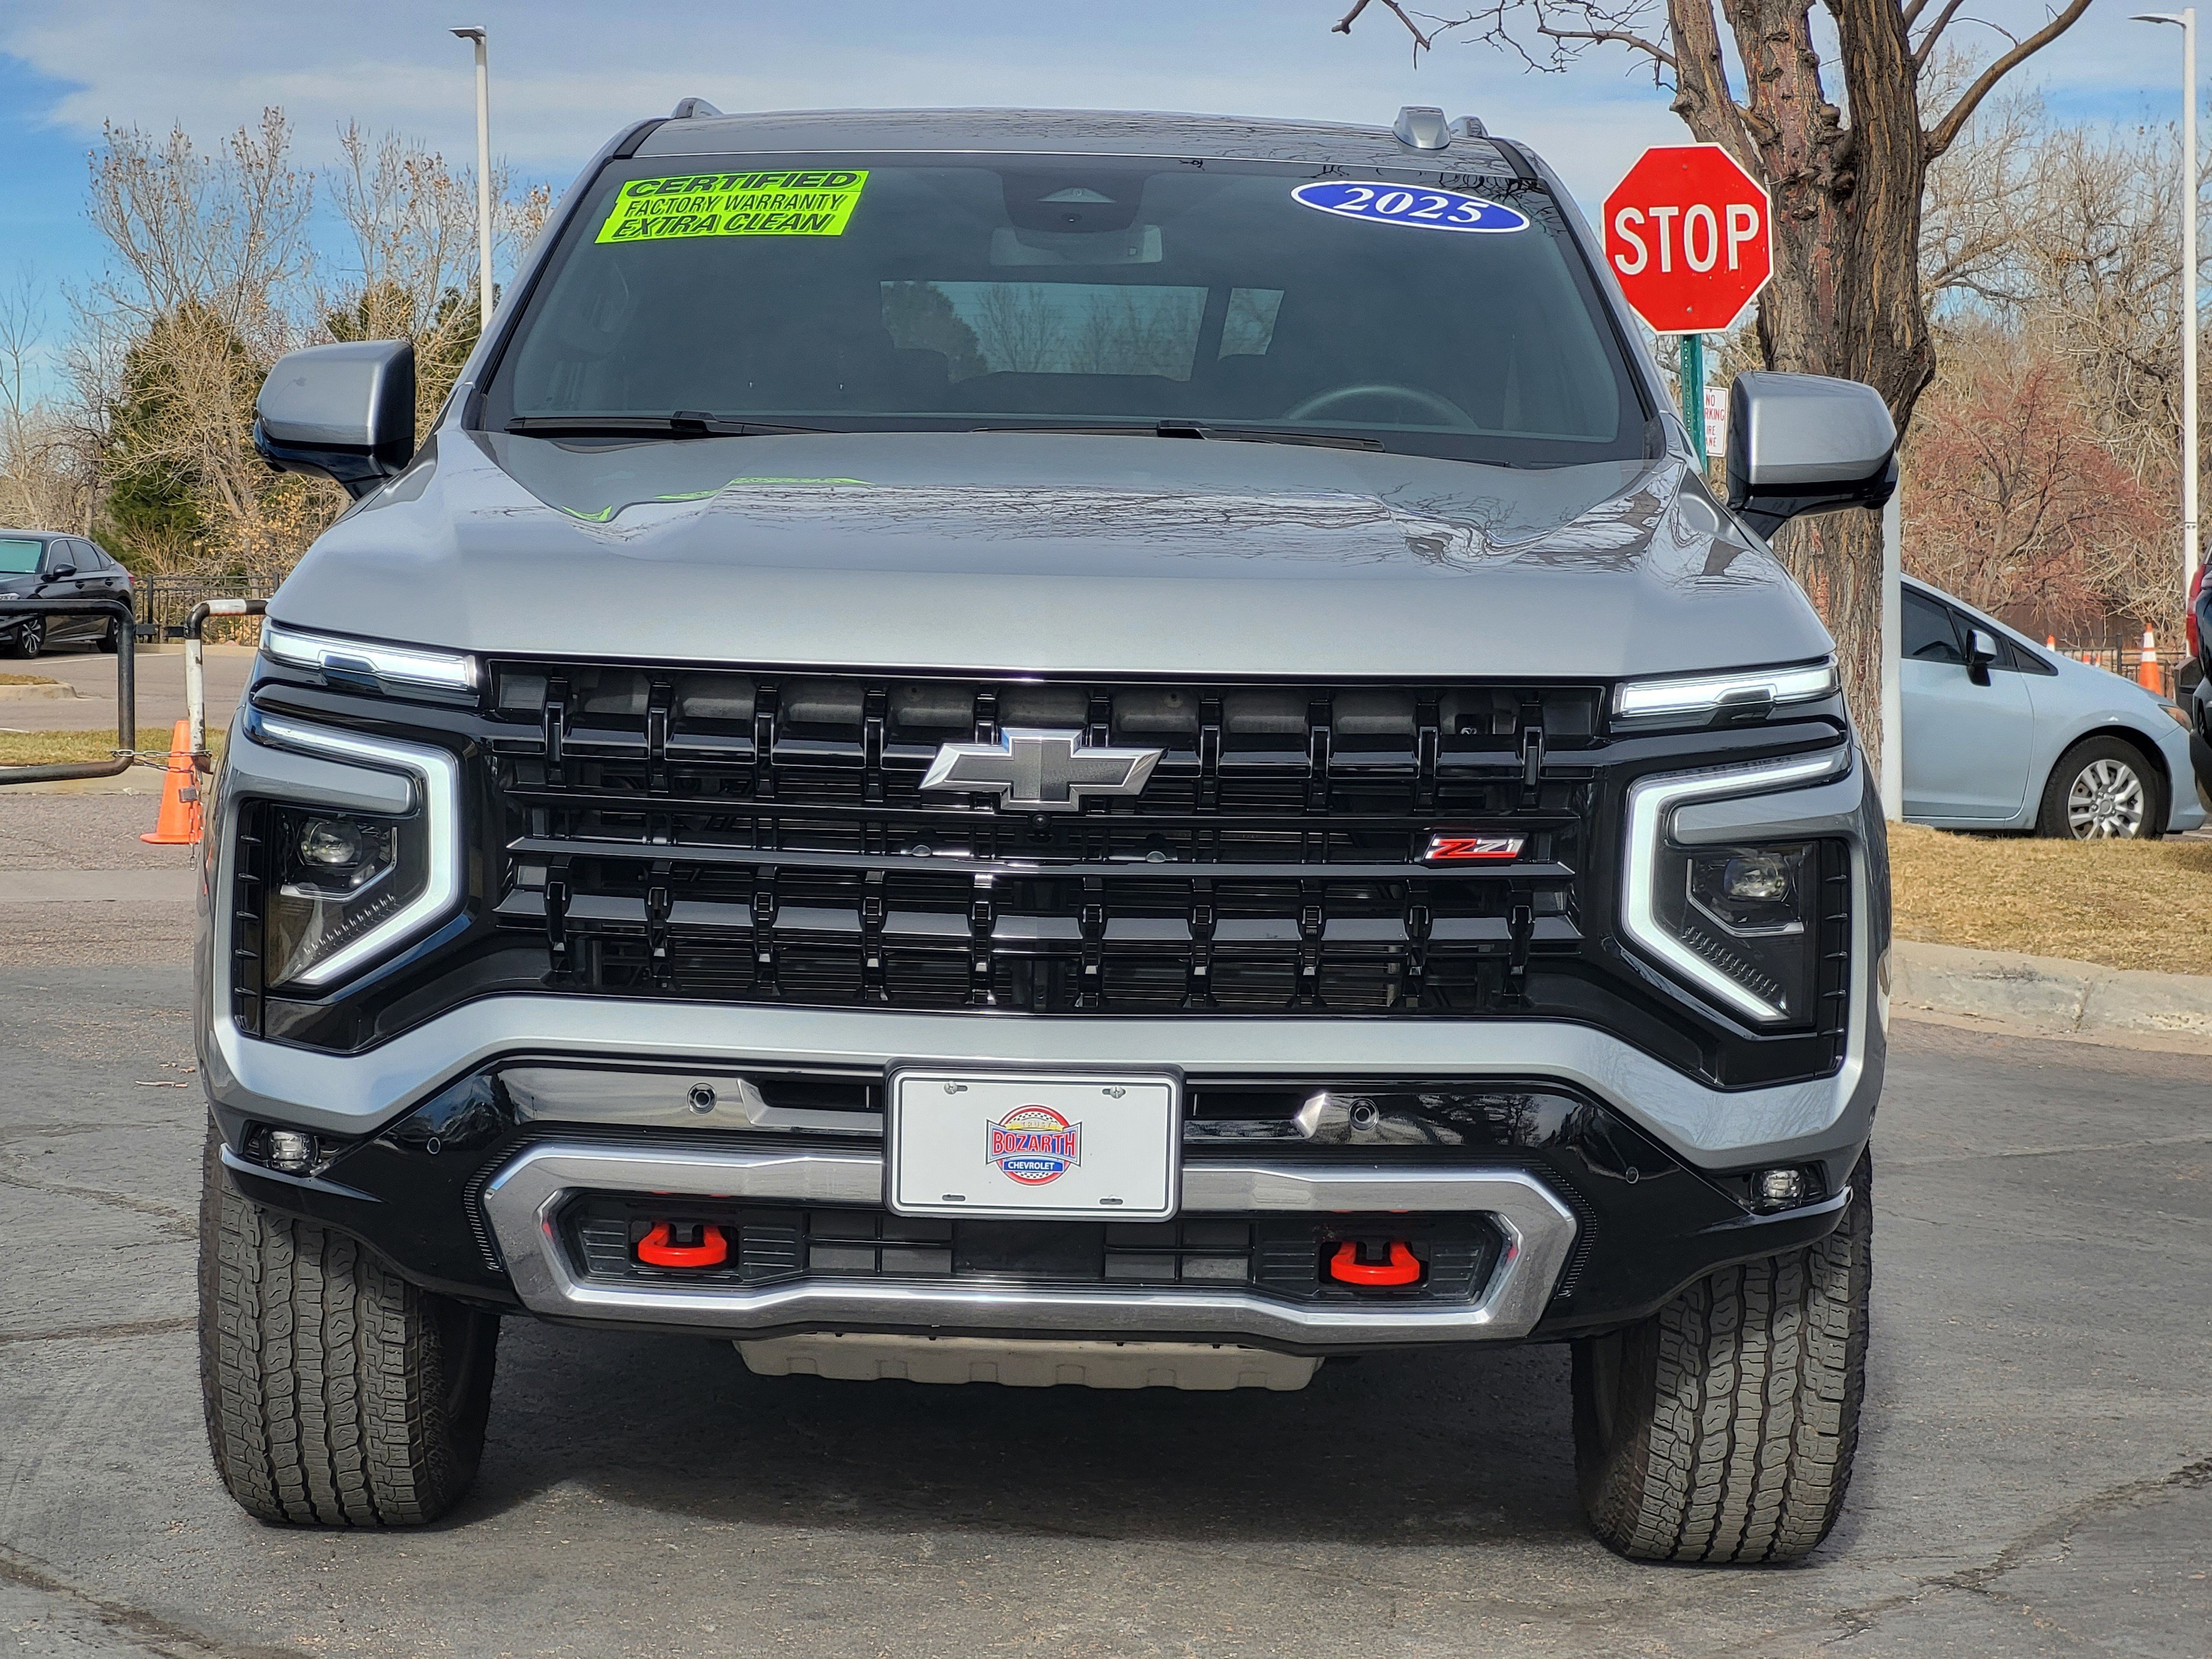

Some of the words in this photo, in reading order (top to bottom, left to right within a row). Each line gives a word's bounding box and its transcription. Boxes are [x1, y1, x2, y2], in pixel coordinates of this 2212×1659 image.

[626, 171, 860, 197] CERTIFIED
[625, 196, 721, 217] FACTORY
[724, 193, 848, 212] WARRANTY
[1333, 187, 1490, 223] 2025
[612, 215, 719, 239] EXTRA
[723, 212, 836, 233] CLEAN
[1614, 204, 1760, 275] STOP
[1705, 394, 1715, 406] NO
[1704, 408, 1725, 421] RKING
[1707, 425, 1715, 435] IRE
[1425, 838, 1524, 859] Z71
[992, 1129, 1076, 1157] BOZARTH
[1008, 1161, 1055, 1170] CHEVROLET
